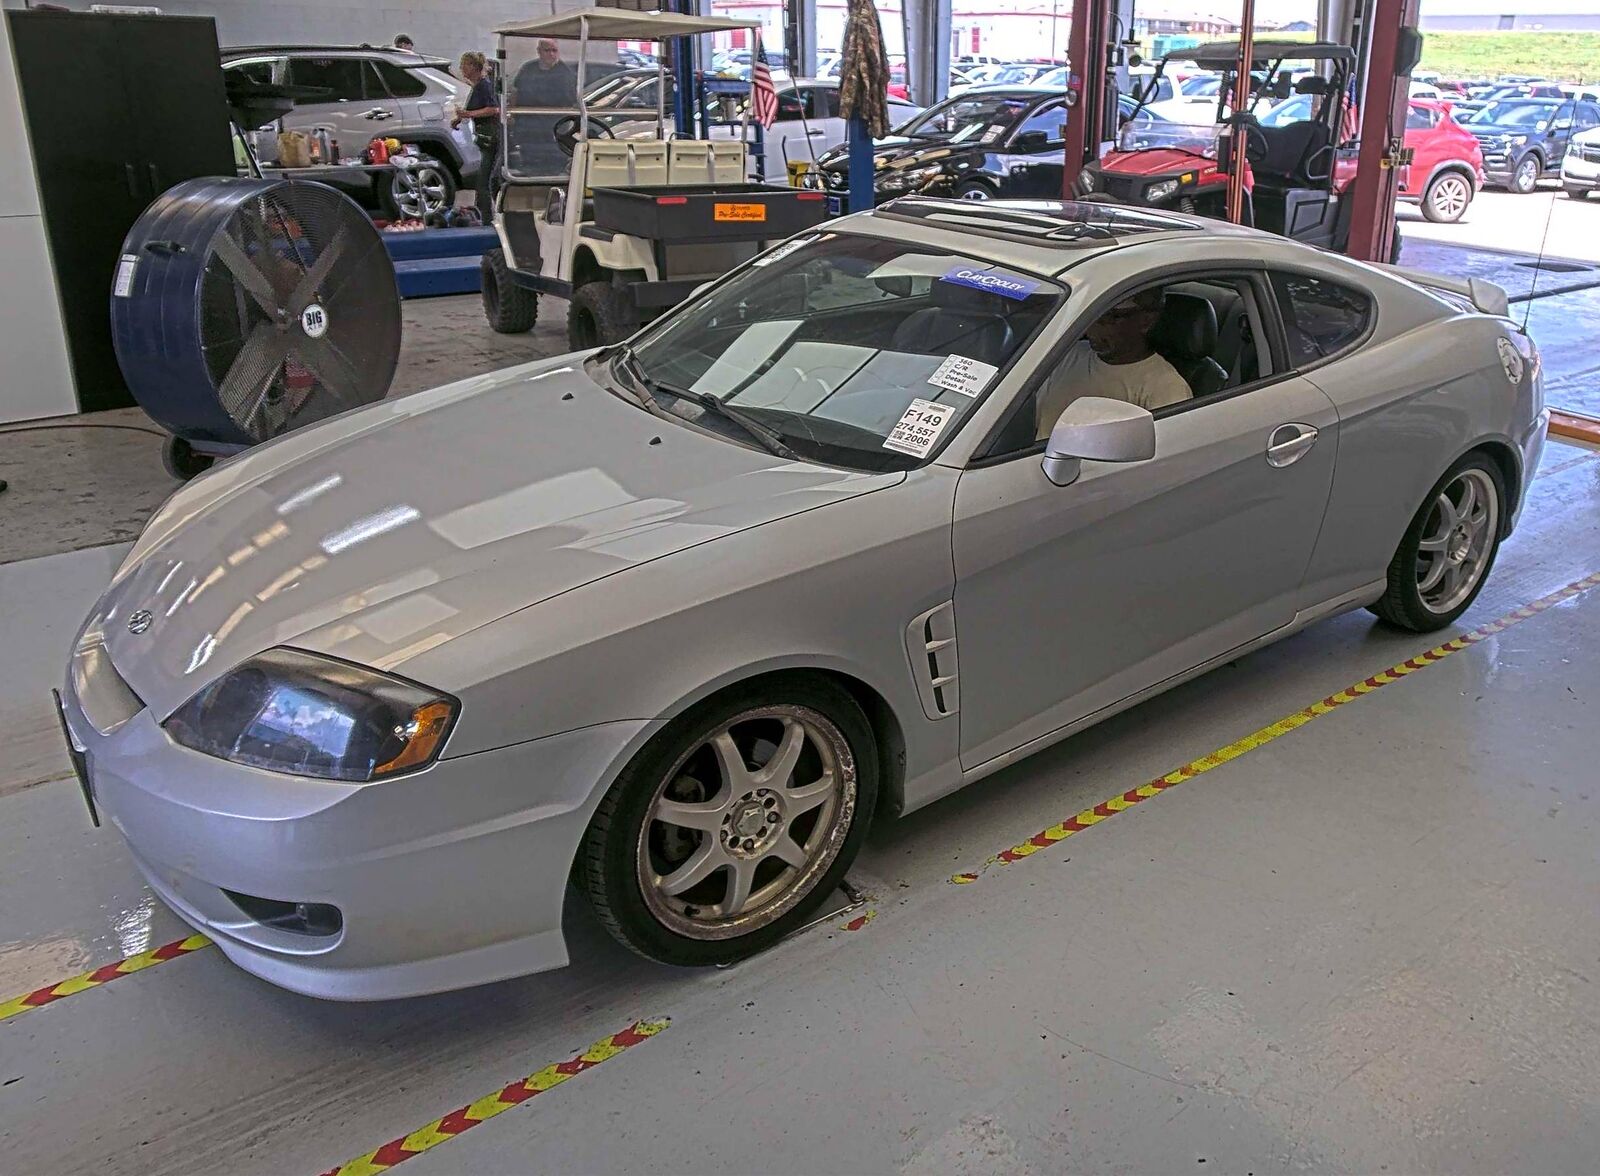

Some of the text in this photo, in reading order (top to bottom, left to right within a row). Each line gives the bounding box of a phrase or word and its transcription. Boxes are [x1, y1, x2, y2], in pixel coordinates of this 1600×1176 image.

[305, 310, 322, 325] BIG
[954, 363, 968, 371] C/R
[958, 358, 973, 366] 360
[945, 374, 966, 384] Detail
[949, 368, 978, 381] Pre-Sale
[941, 380, 957, 389] Wash
[964, 388, 977, 396] Vac
[904, 409, 942, 427] F149
[904, 433, 930, 446] 2006
